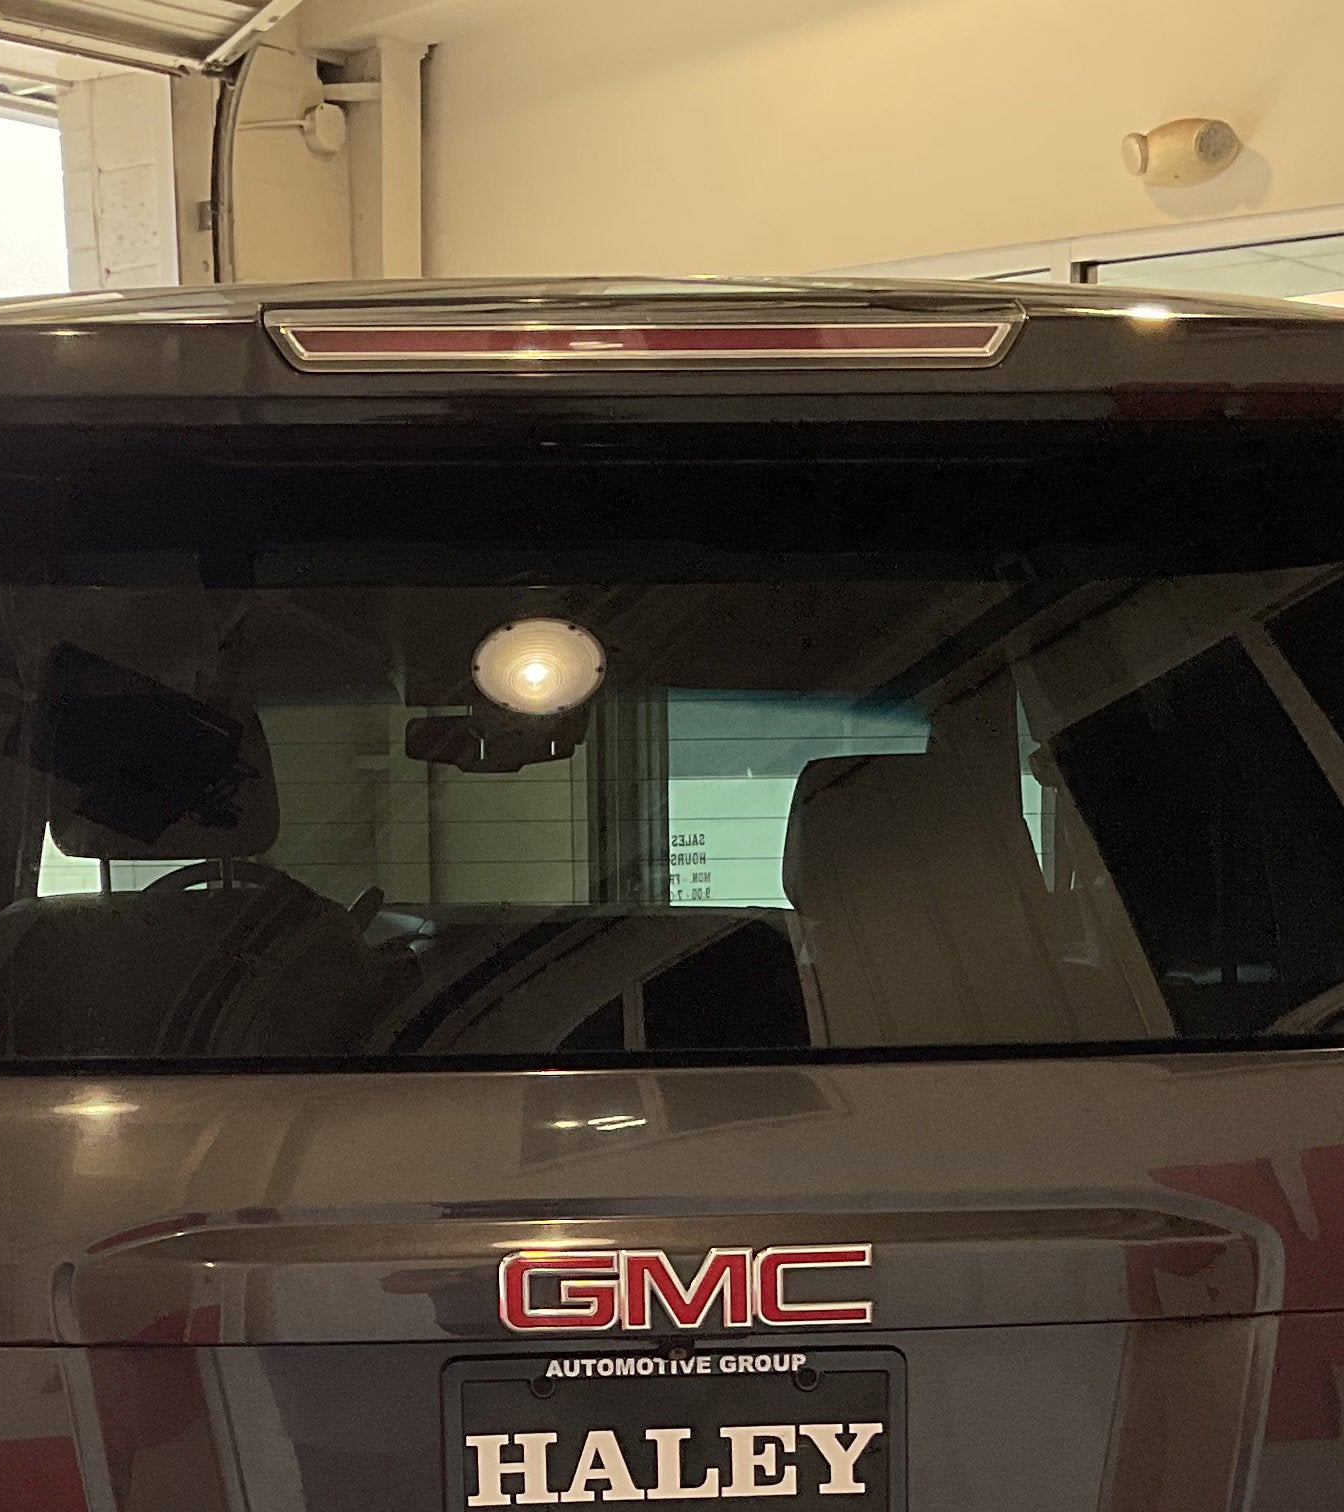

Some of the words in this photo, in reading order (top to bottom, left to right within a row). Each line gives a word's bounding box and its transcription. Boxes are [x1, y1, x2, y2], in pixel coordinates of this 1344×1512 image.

[498, 1243, 873, 1331] GMC
[545, 1356, 712, 1378] AUTOMOTIVE
[719, 1353, 807, 1374] GROUP
[465, 1422, 883, 1507] HALEY
